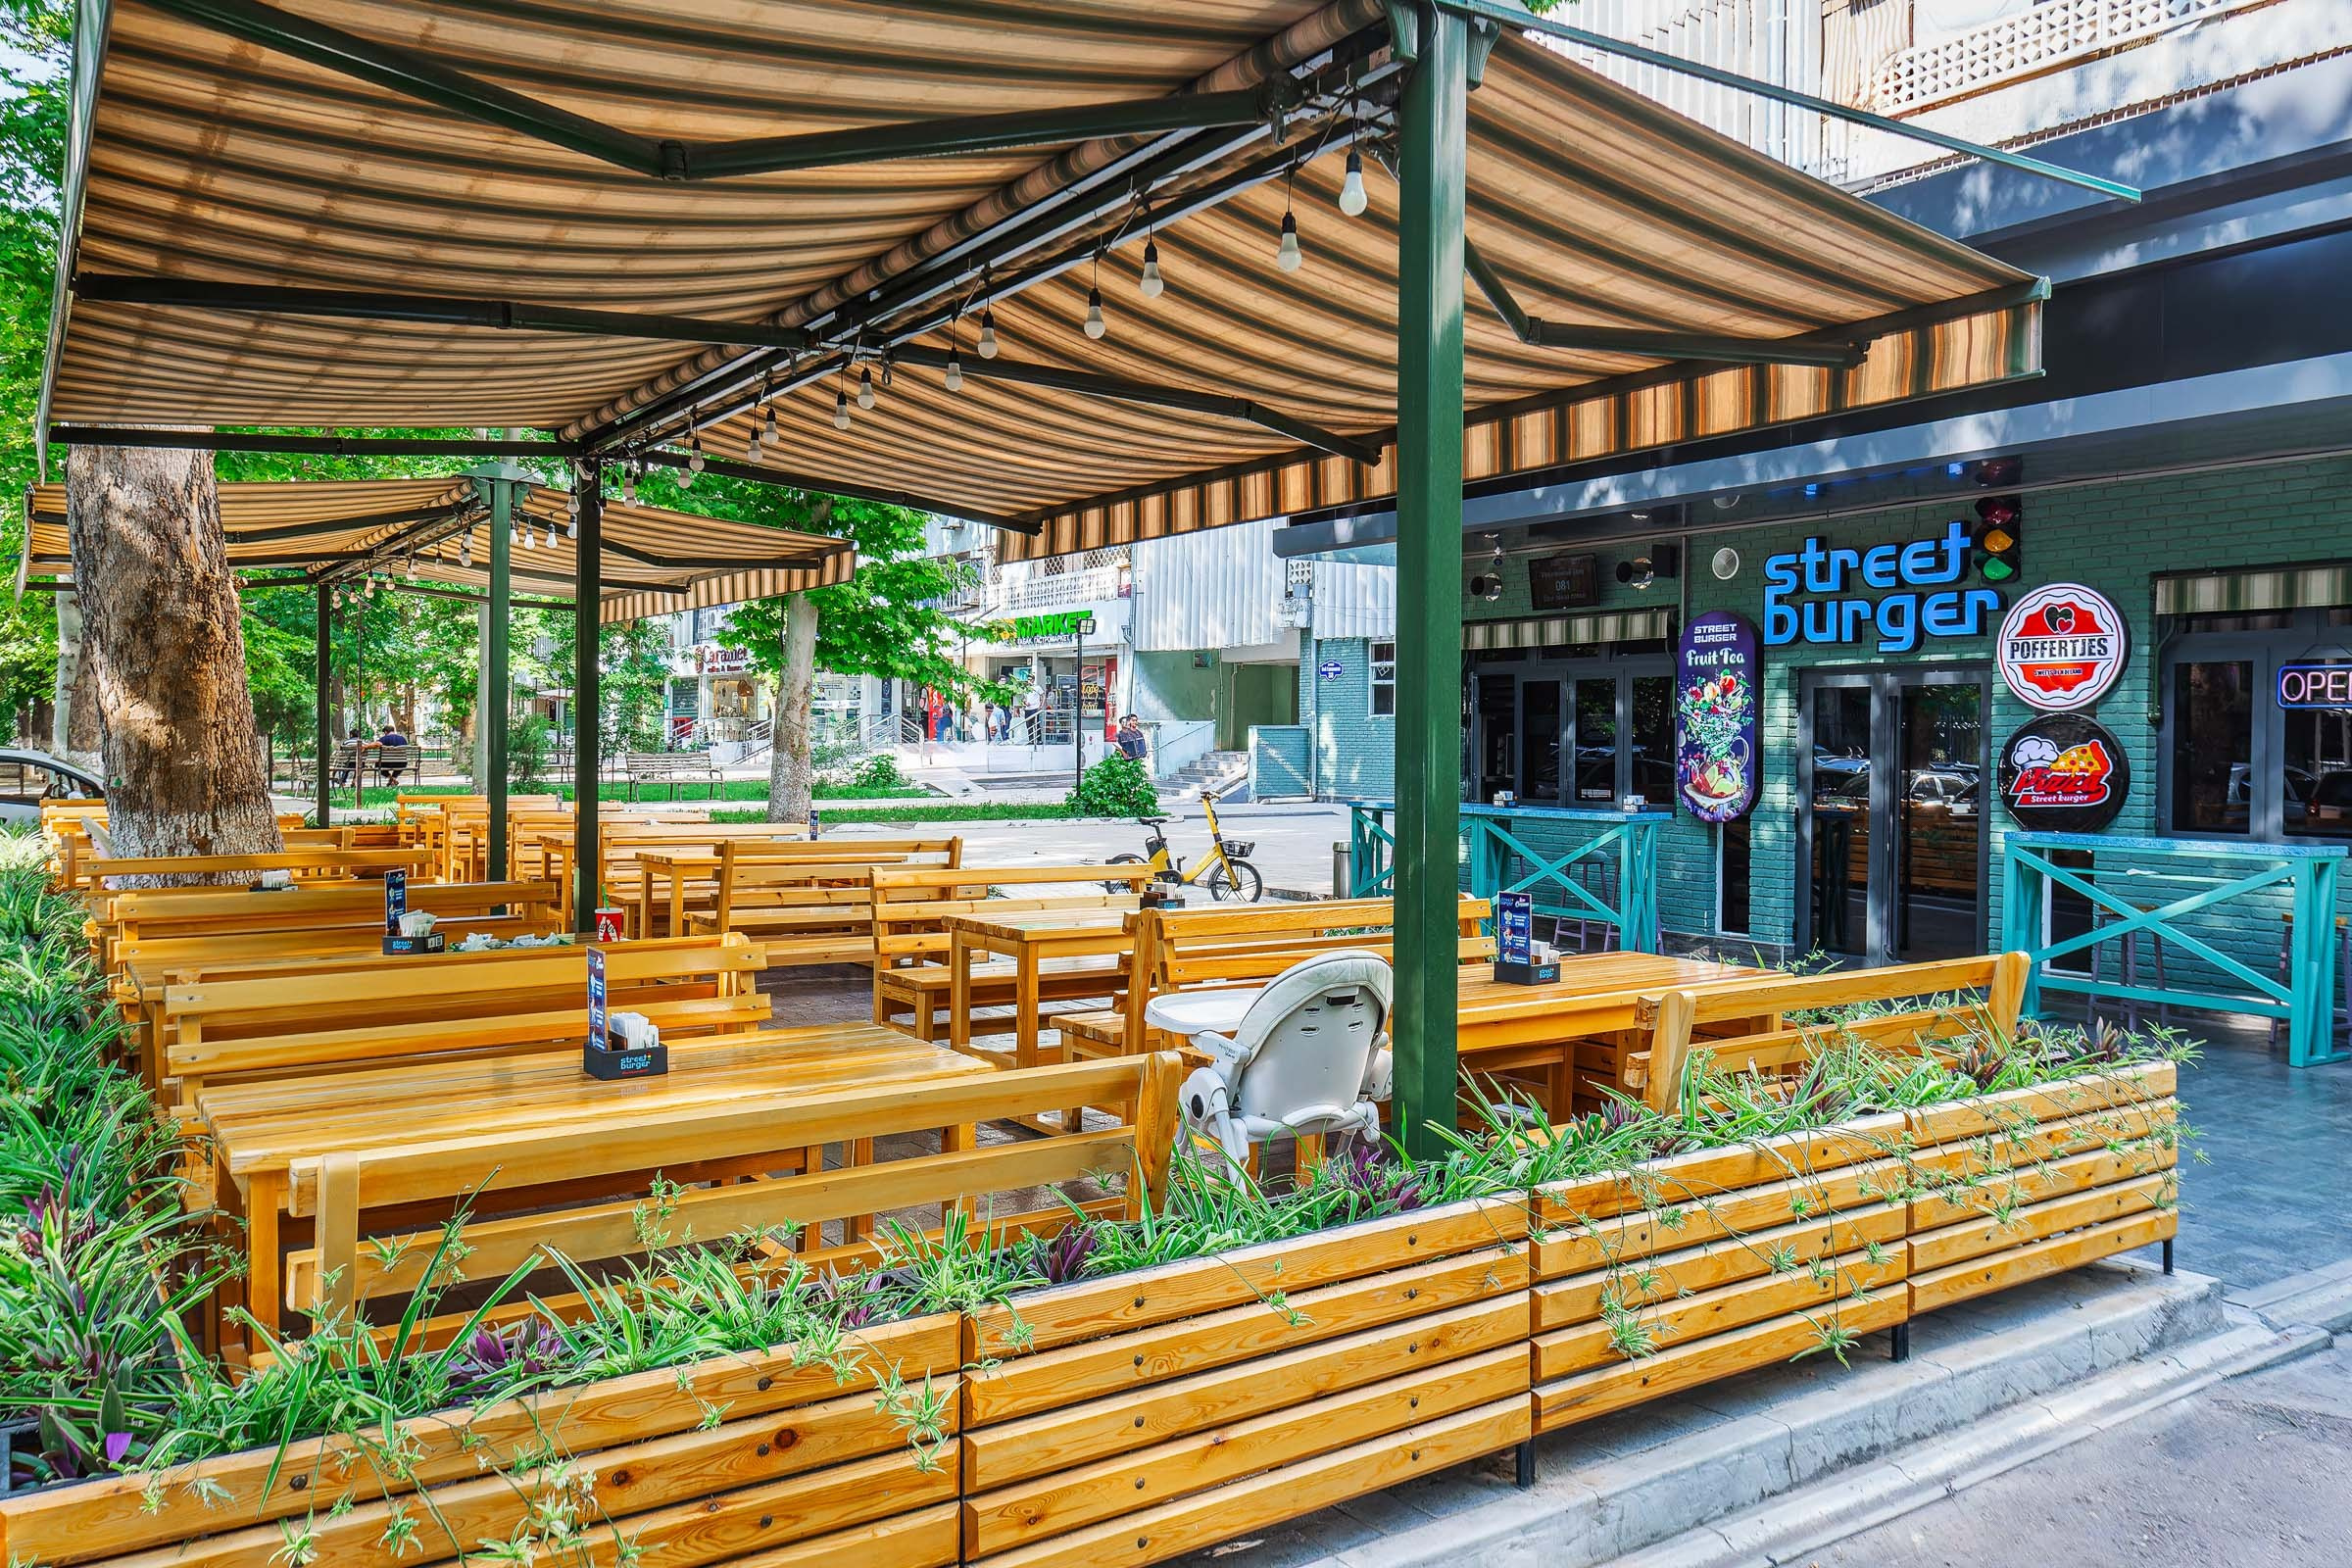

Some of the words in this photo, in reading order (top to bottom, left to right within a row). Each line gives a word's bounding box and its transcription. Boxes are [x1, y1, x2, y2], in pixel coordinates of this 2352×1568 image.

[1765, 521, 1971, 594] street
[1693, 623, 1737, 634] STREET
[1764, 585, 1999, 653] burger
[1693, 633, 1737, 644] BURGER
[2010, 638, 2108, 659] POFFERTJES
[1686, 649, 1719, 666] Fruit
[1719, 647, 1745, 664] Tea
[2281, 671, 2352, 702] OPE
[2012, 768, 2102, 792] Pizza
[620, 1054, 647, 1063] street
[620, 1061, 651, 1070] burger
